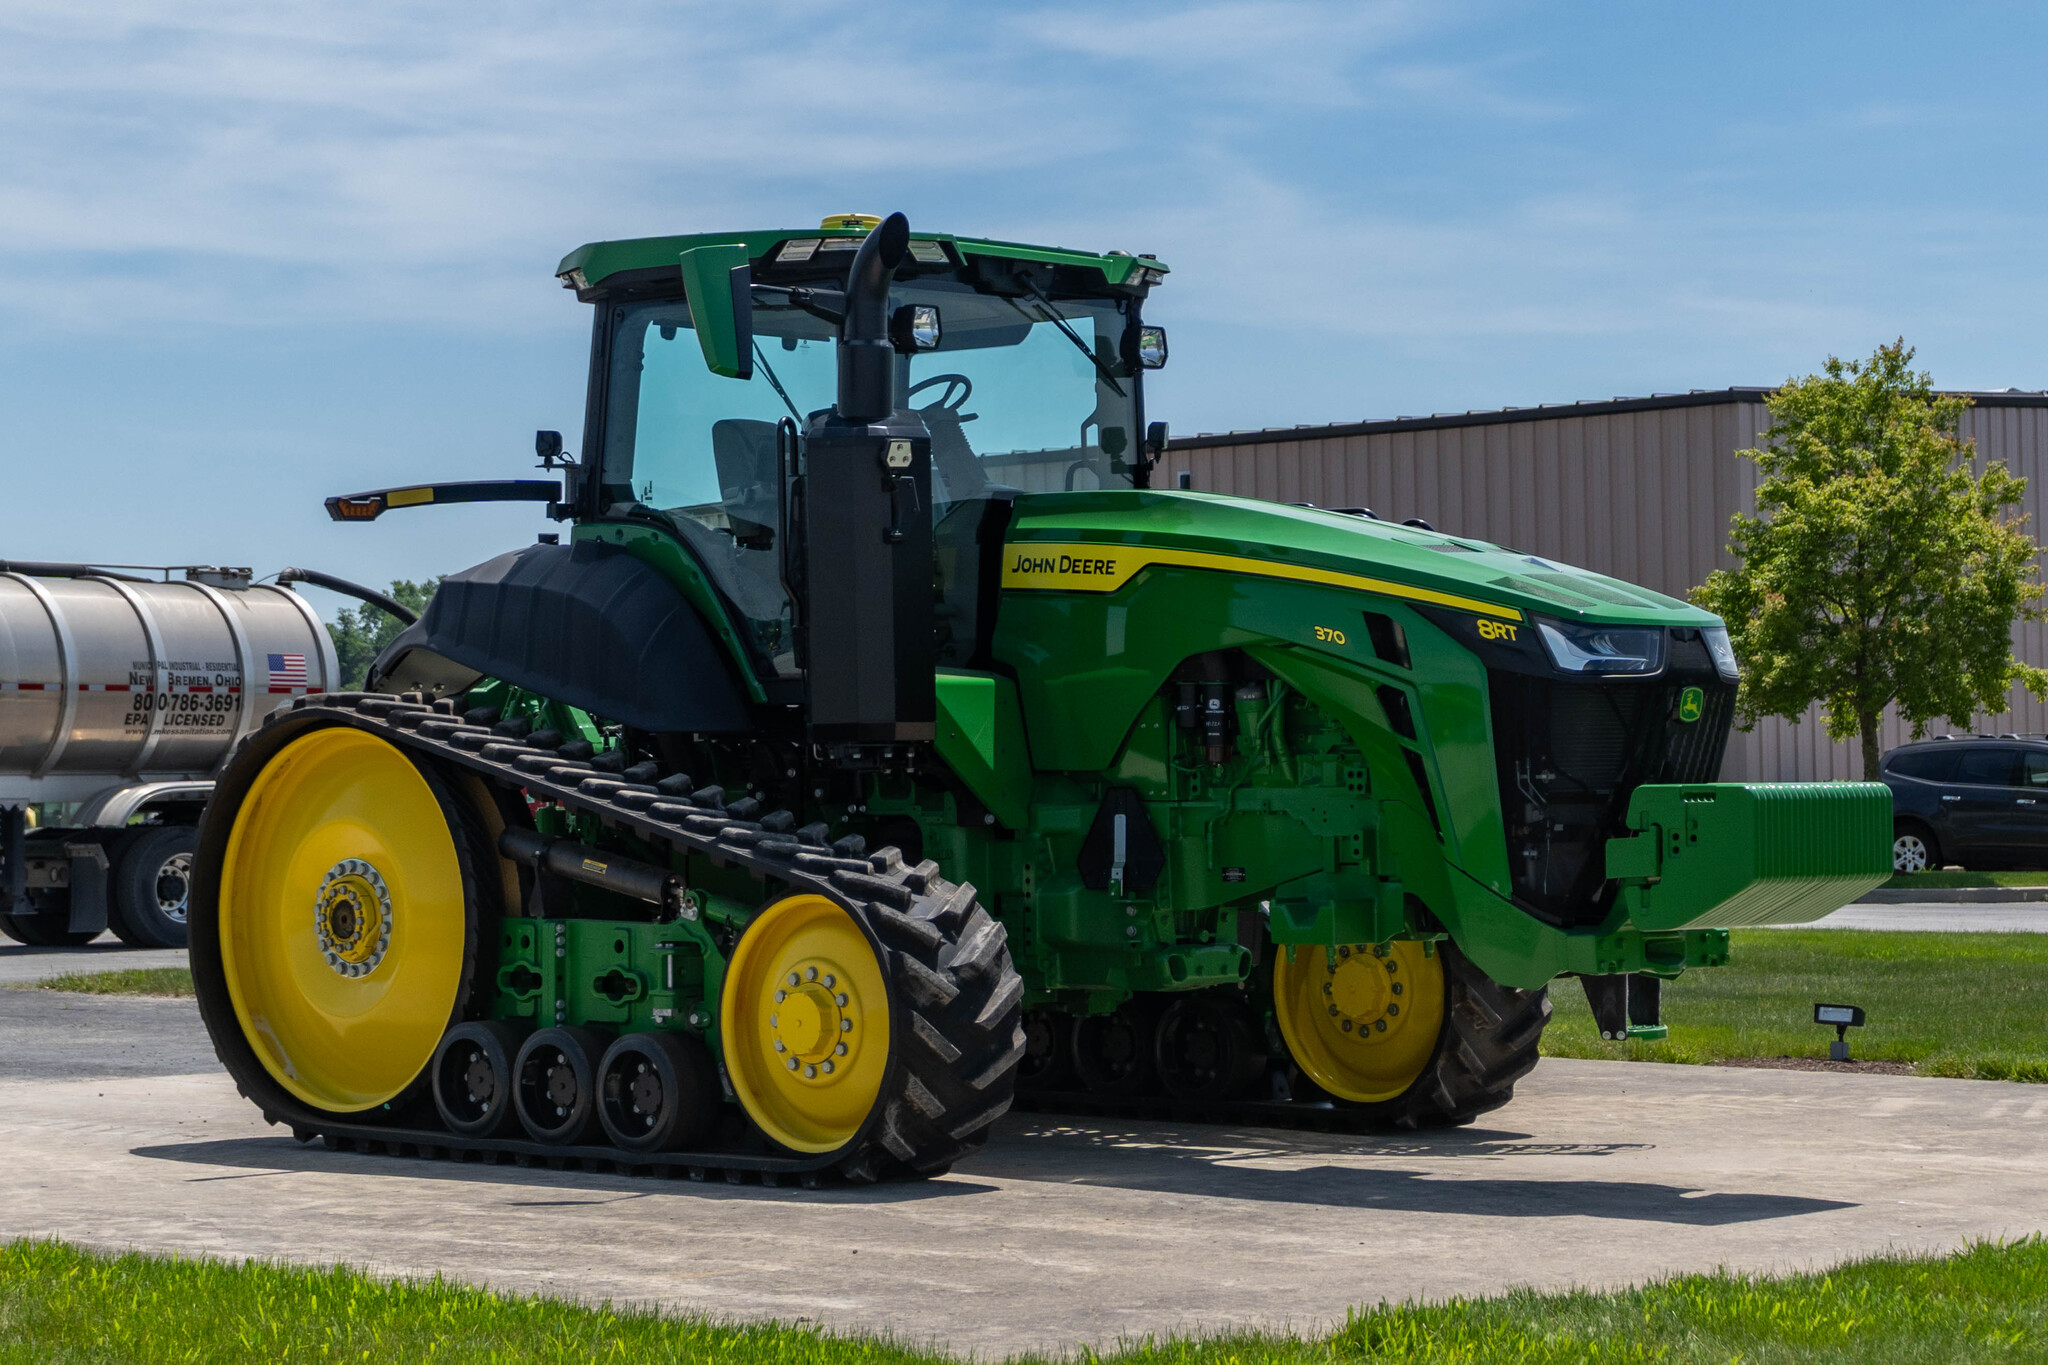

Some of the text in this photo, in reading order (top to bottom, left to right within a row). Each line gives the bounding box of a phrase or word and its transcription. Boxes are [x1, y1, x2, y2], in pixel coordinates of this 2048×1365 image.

[1012, 555, 1117, 575] JOHN DEERE
[1313, 625, 1346, 646] 370
[1476, 619, 1518, 642] 8RT
[169, 661, 201, 672] INDUSTRIAL
[206, 662, 241, 672] RESIDENTIAL
[129, 671, 154, 685] NEW
[216, 674, 241, 687] OHIO
[124, 713, 225, 726] EPA LICENSED
